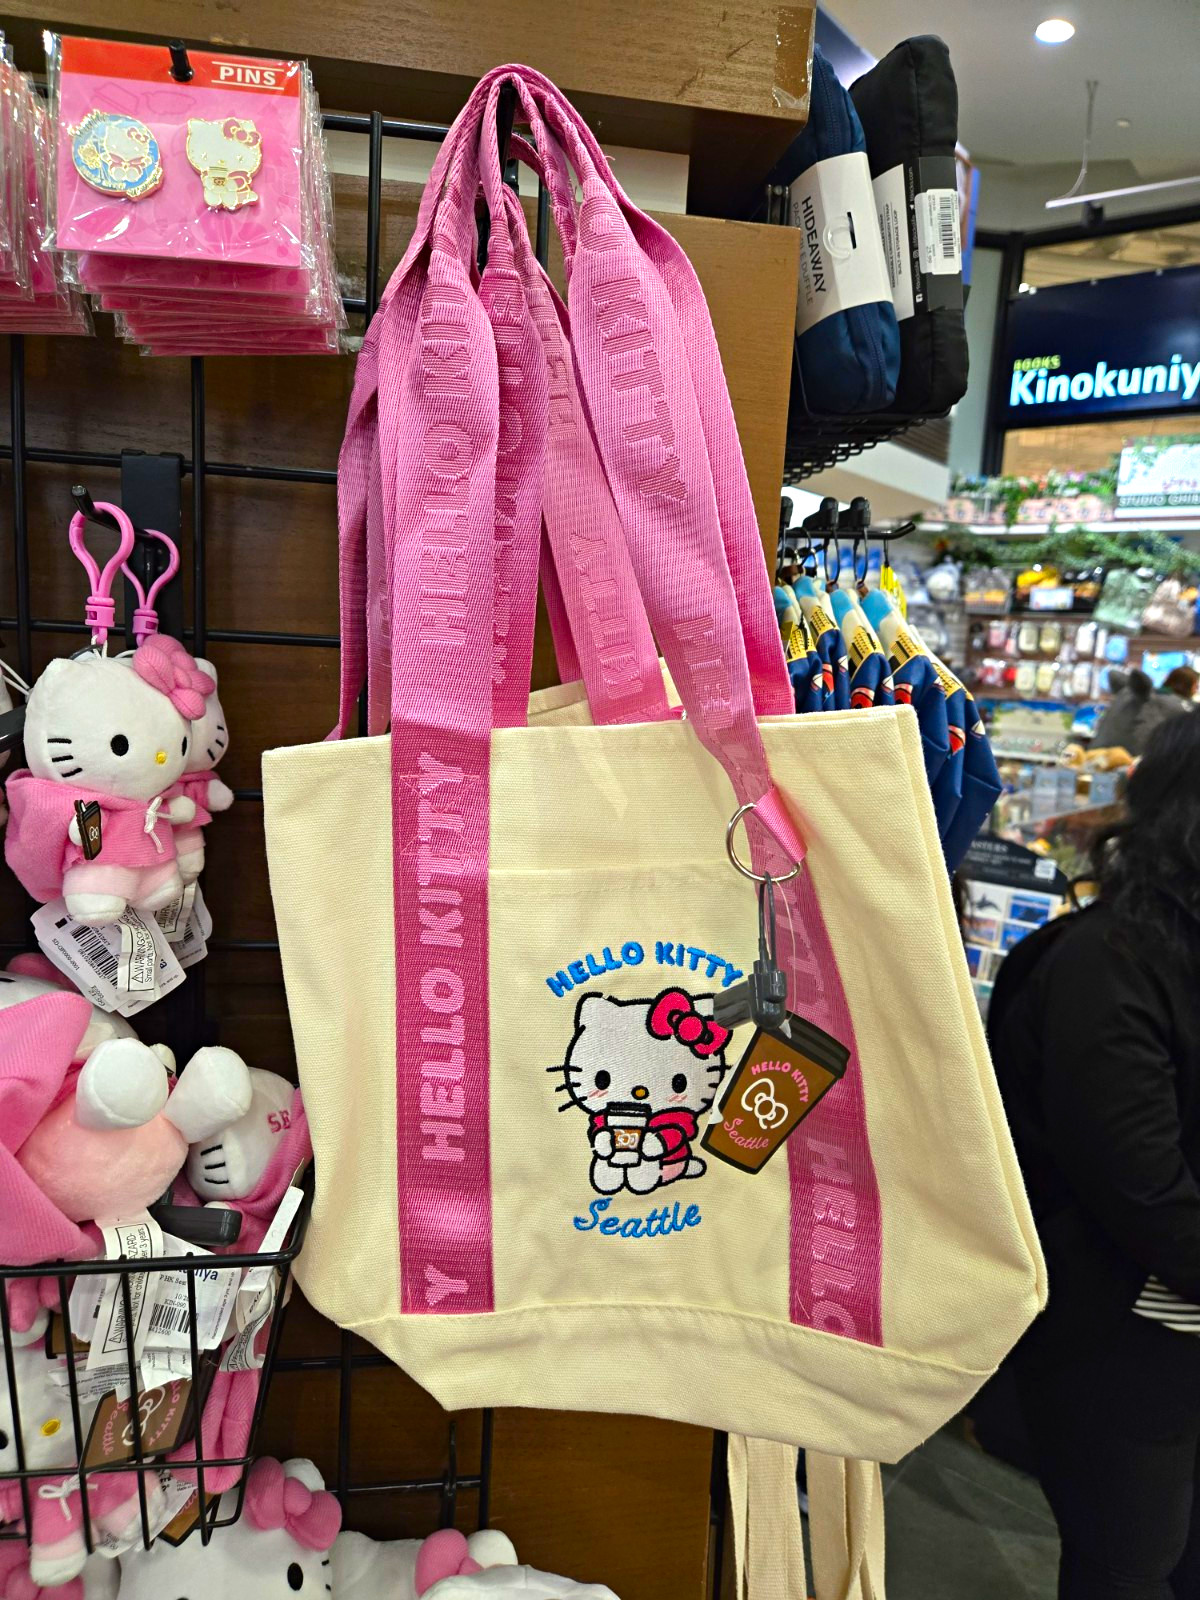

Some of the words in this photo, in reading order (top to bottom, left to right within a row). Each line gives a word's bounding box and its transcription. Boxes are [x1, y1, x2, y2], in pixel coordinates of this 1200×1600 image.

[220, 67, 277, 86] PINS
[793, 202, 806, 262] PACBLE
[800, 263, 813, 305] DUFFLE
[801, 196, 826, 293] HIDEAWAY
[592, 277, 688, 503] KITTY
[1013, 354, 1061, 371] BOOKS
[1119, 495, 1166, 507] STUDIO
[418, 423, 474, 645] HELLO
[569, 532, 643, 700] KITTY
[418, 750, 465, 948] KITTY
[144, 967, 153, 983] Small
[546, 941, 645, 998] HELLO
[655, 941, 744, 988] KITTY
[418, 966, 466, 1163] HELLO
[751, 1061, 791, 1076] HELLO
[791, 1069, 809, 1103] KITTY
[723, 1118, 769, 1150] Seattle
[573, 1197, 702, 1238] Seattle
[103, 1401, 129, 1456] Seattle
[148, 1406, 177, 1447] KITTY
